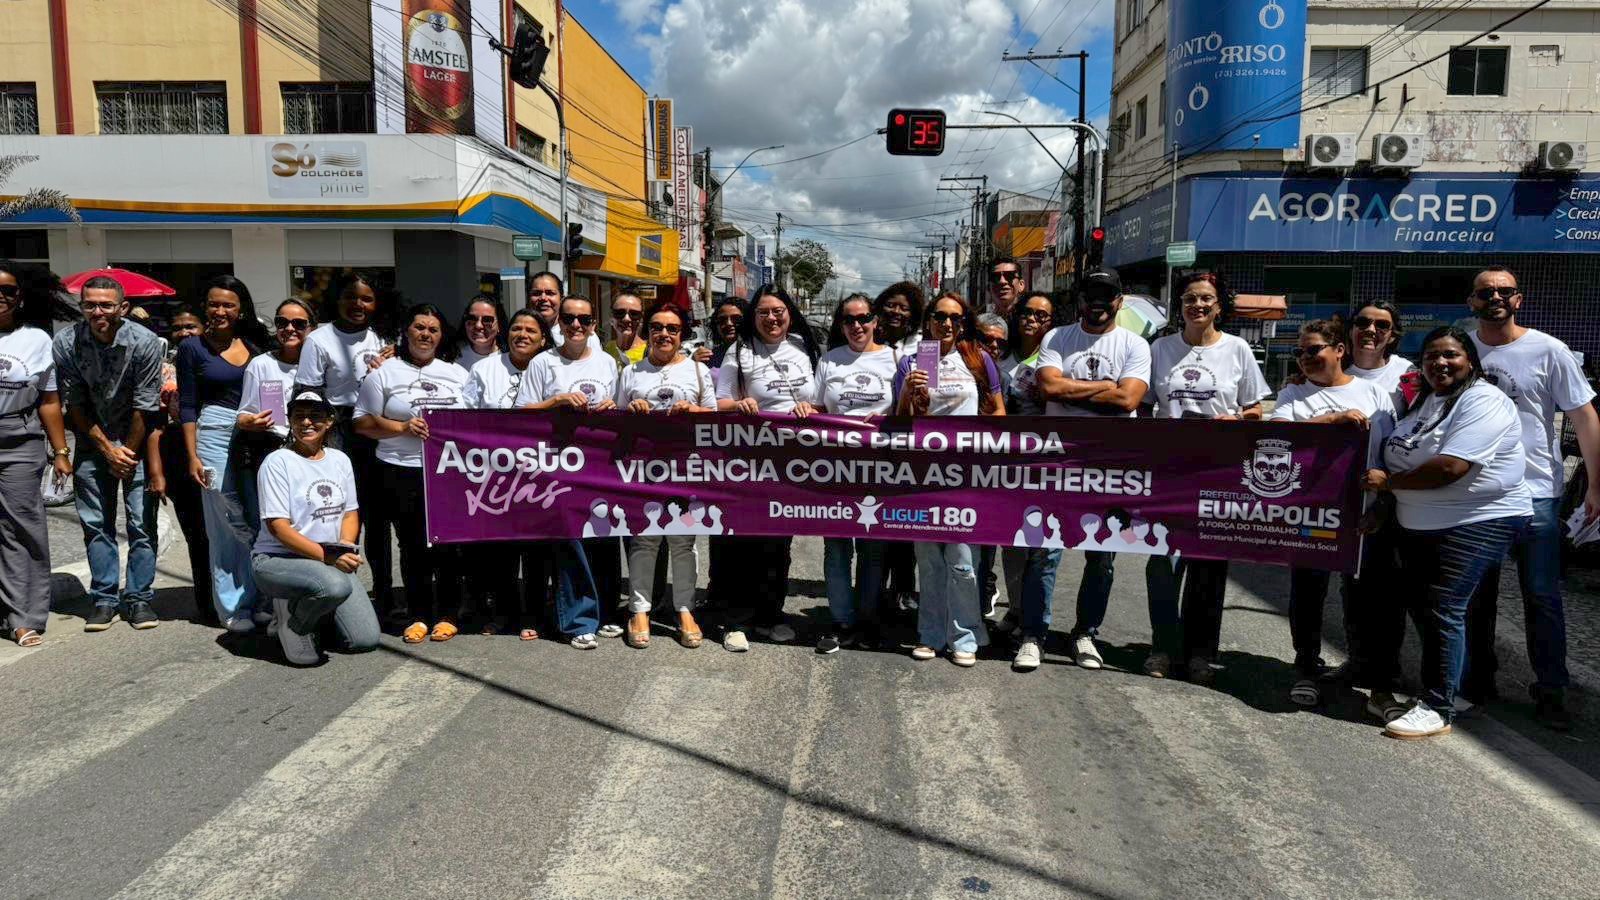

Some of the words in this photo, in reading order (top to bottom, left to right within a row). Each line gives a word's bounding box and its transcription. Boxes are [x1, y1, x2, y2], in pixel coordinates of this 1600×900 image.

[412, 47, 466, 69] AMSTEL
[423, 69, 457, 83] LAGER
[657, 102, 669, 177] PERNAMBUCANAS
[914, 120, 940, 145] 35
[676, 127, 686, 167] LOJAS
[271, 142, 317, 178] Só
[300, 168, 363, 178] COLCHÕES
[320, 178, 365, 198] prime
[1569, 187, 1600, 203] Emp
[676, 170, 687, 249] AMERICANAS
[1248, 192, 1497, 223] AGORACRED
[1393, 226, 1495, 244] Financeira
[695, 420, 863, 448] EUNÁPOLIS
[870, 431, 949, 453] PELO
[956, 431, 1011, 454] FIM
[1019, 431, 1066, 454] DA
[436, 441, 585, 484] Agosto
[615, 453, 780, 483] VIOLÊNCIA
[785, 458, 917, 486] CONTRA
[923, 462, 964, 487] AS
[971, 464, 1152, 497] MULHERES!
[464, 459, 572, 516] Lilás
[1199, 489, 1257, 501] PREFEITURA
[769, 500, 853, 520] Denuncie
[882, 507, 929, 523] LIGUE
[928, 506, 977, 527] 180
[1198, 499, 1341, 529] EUNÁPOLIS
[883, 522, 904, 530] Central
[912, 524, 949, 532] Atendimento
[953, 525, 974, 533] Mulher
[1206, 520, 1235, 530] FORÇA
[1237, 523, 1251, 531] DO
[1252, 524, 1299, 535] TRABALHO
[1199, 532, 1233, 541] Secretaria
[1234, 535, 1267, 545] Municipal
[1268, 536, 1277, 545] de
[1278, 539, 1316, 550] Assistência
[1317, 542, 1338, 552] Social
